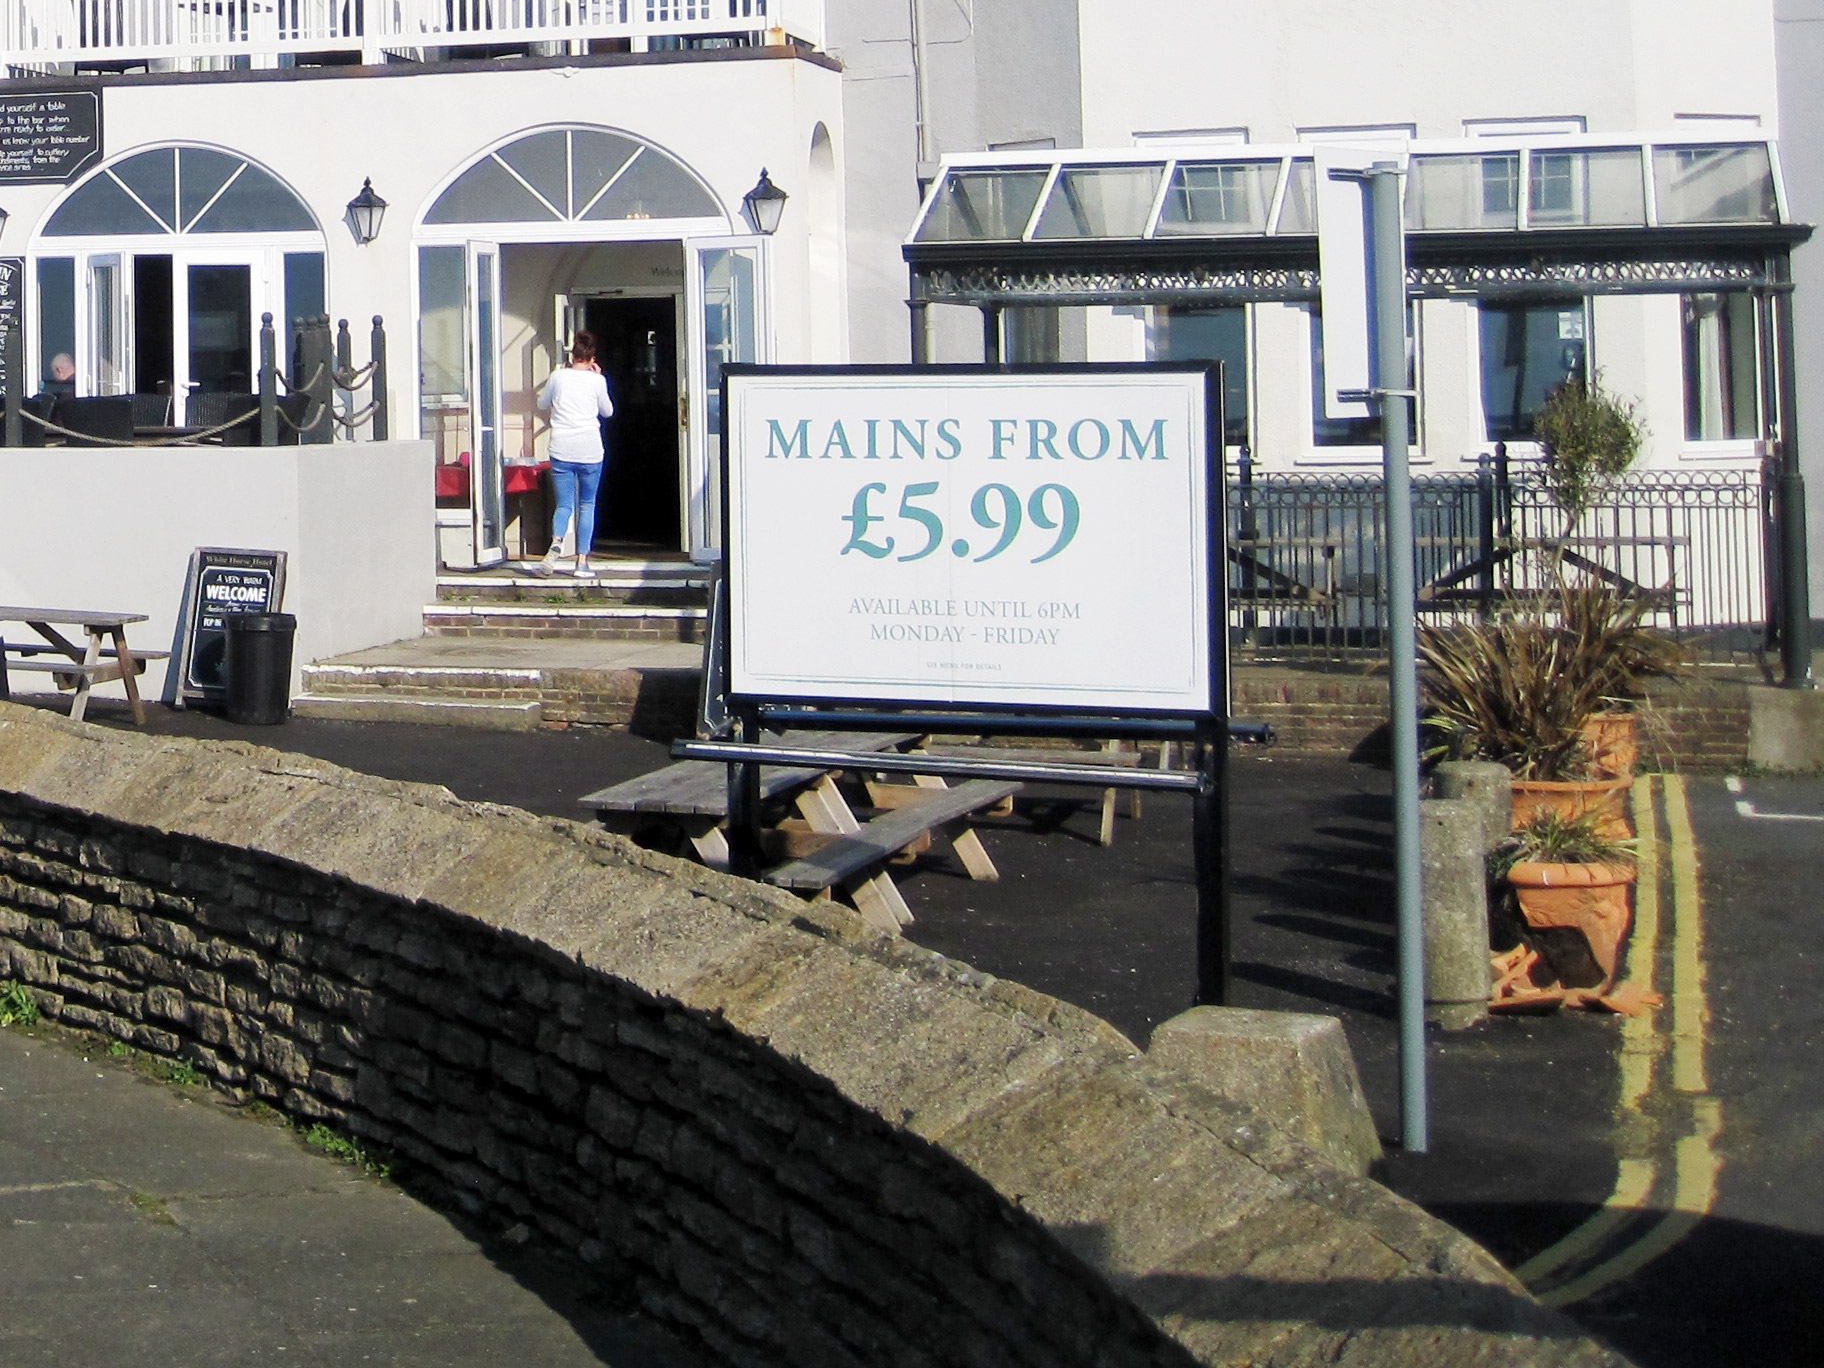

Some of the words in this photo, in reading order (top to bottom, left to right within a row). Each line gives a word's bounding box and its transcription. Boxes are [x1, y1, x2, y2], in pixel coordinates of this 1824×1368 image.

[765, 418, 962, 460] MAINS
[987, 418, 1169, 460] FROM
[840, 481, 1080, 564] £5.99
[216, 574, 223, 582] A
[224, 575, 241, 584] VERY
[206, 584, 267, 603] WELCOME
[848, 598, 958, 616] AVAILABLE
[964, 600, 1032, 618] UNTIL
[1037, 601, 1080, 619] 6PM
[870, 623, 965, 643] MONDAY
[984, 626, 1060, 645] FRIDAY
